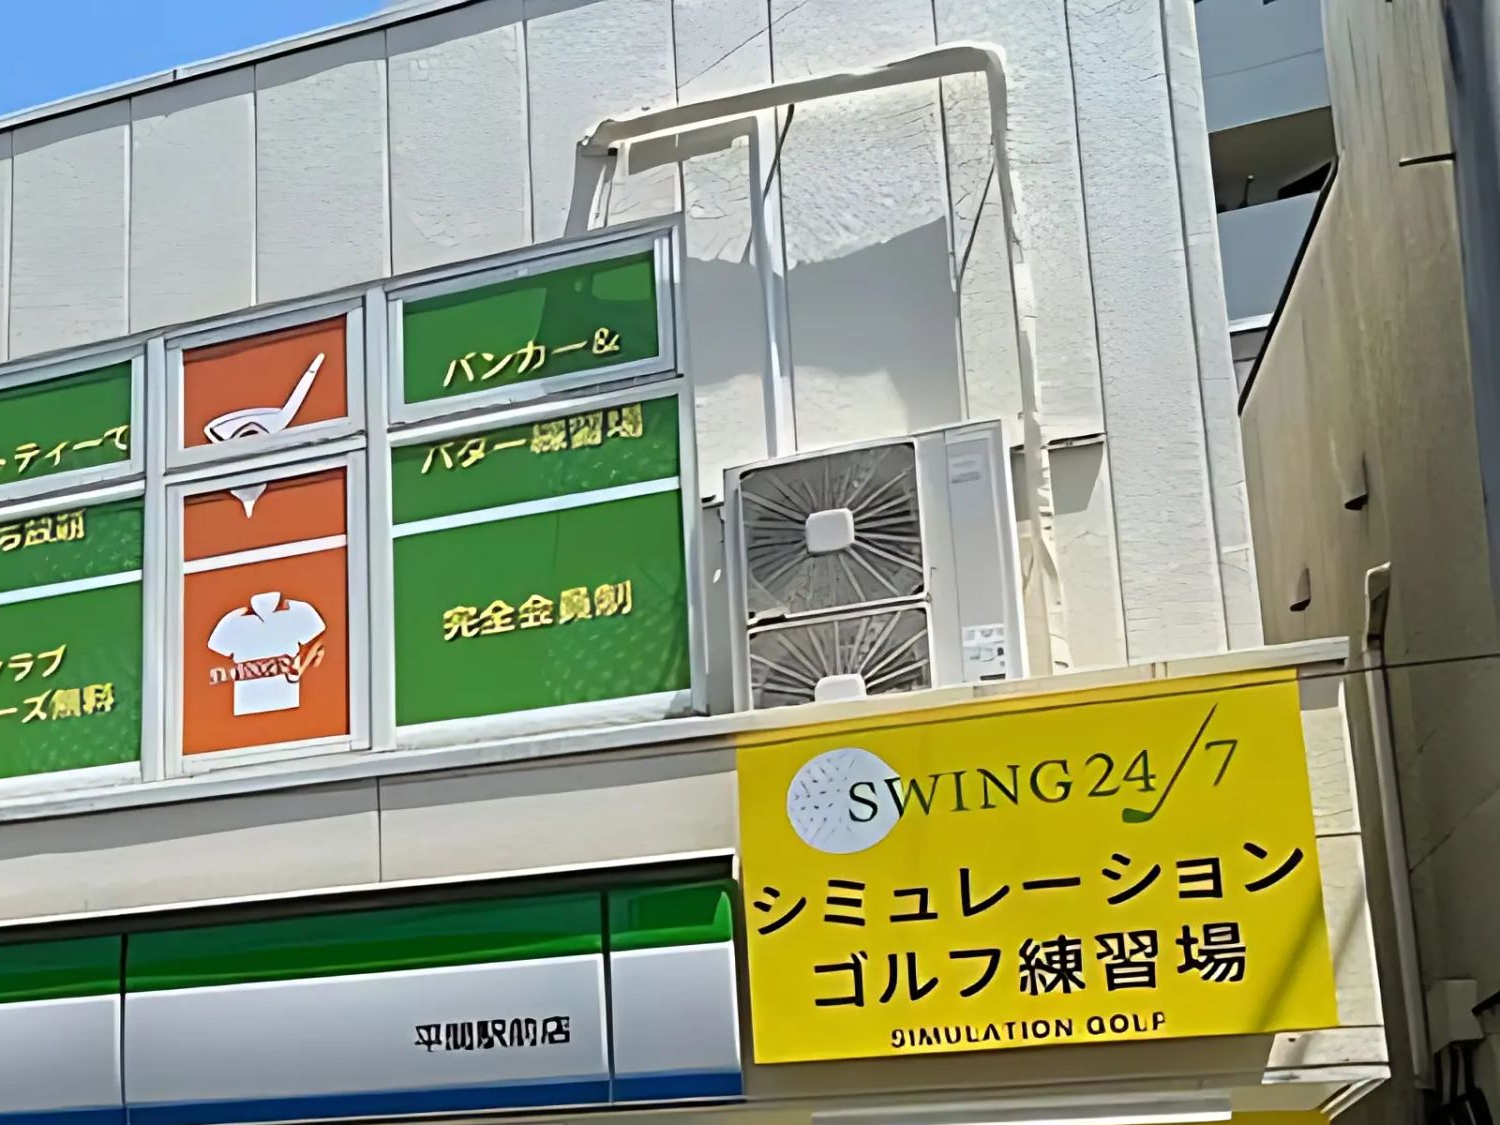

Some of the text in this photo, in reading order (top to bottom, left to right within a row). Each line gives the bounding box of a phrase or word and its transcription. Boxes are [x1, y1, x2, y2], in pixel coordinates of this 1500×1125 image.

[752, 841, 1304, 936] シミュレーション
[813, 922, 1248, 1008] ゴルフ練習場
